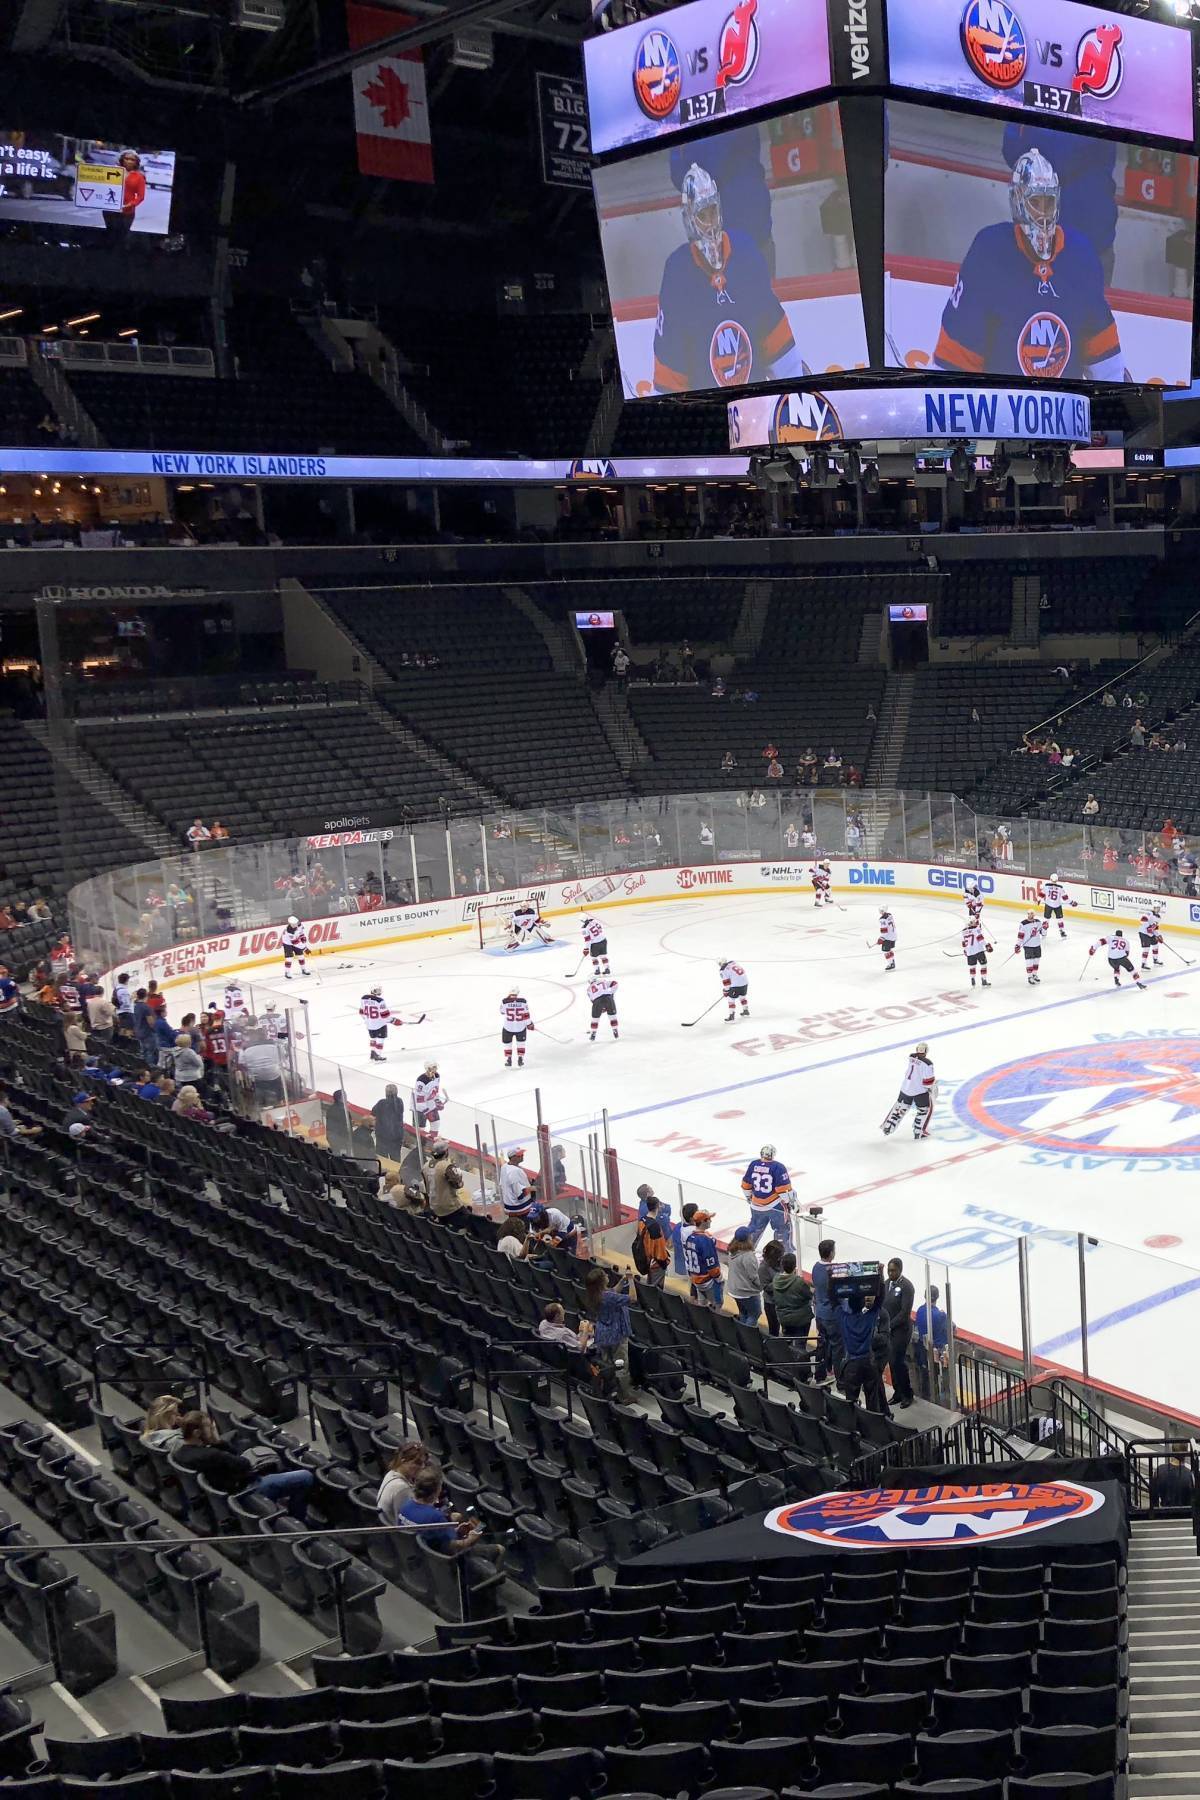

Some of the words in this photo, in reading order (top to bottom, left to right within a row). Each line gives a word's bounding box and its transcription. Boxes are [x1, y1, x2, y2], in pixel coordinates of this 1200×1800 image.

[686, 47, 709, 75] VS
[1035, 37, 1063, 68] VS
[686, 91, 718, 121] 1:37
[1033, 84, 1072, 112] 1:37
[553, 120, 589, 153] 72
[17, 149, 51, 163] easy,
[5, 164, 14, 174] a
[16, 162, 39, 177] life
[41, 165, 58, 179] is.
[924, 393, 999, 434] NEW
[1007, 395, 1066, 435] YORK
[152, 453, 190, 474] NEW
[197, 455, 238, 475] YORK
[242, 456, 326, 476] ISLANDERS
[68, 586, 172, 601] HONDA
[306, 831, 363, 849] KENDA
[623, 874, 647, 898] Stoli
[676, 869, 733, 889] SHOWTIME
[928, 868, 995, 893] GEICO
[561, 882, 583, 906] Stoli
[405, 909, 440, 921] BOUNTY
[307, 921, 341, 945] OIL
[161, 938, 230, 966] RICHARD
[1110, 940, 1127, 951] 39
[164, 966, 176, 978] &
[178, 957, 206, 975] SON
[364, 1006, 379, 1019] 46
[505, 1008, 523, 1022] 55
[798, 1006, 869, 1024] NHL
[751, 1173, 773, 1192] 33
[705, 1257, 716, 1267] 13
